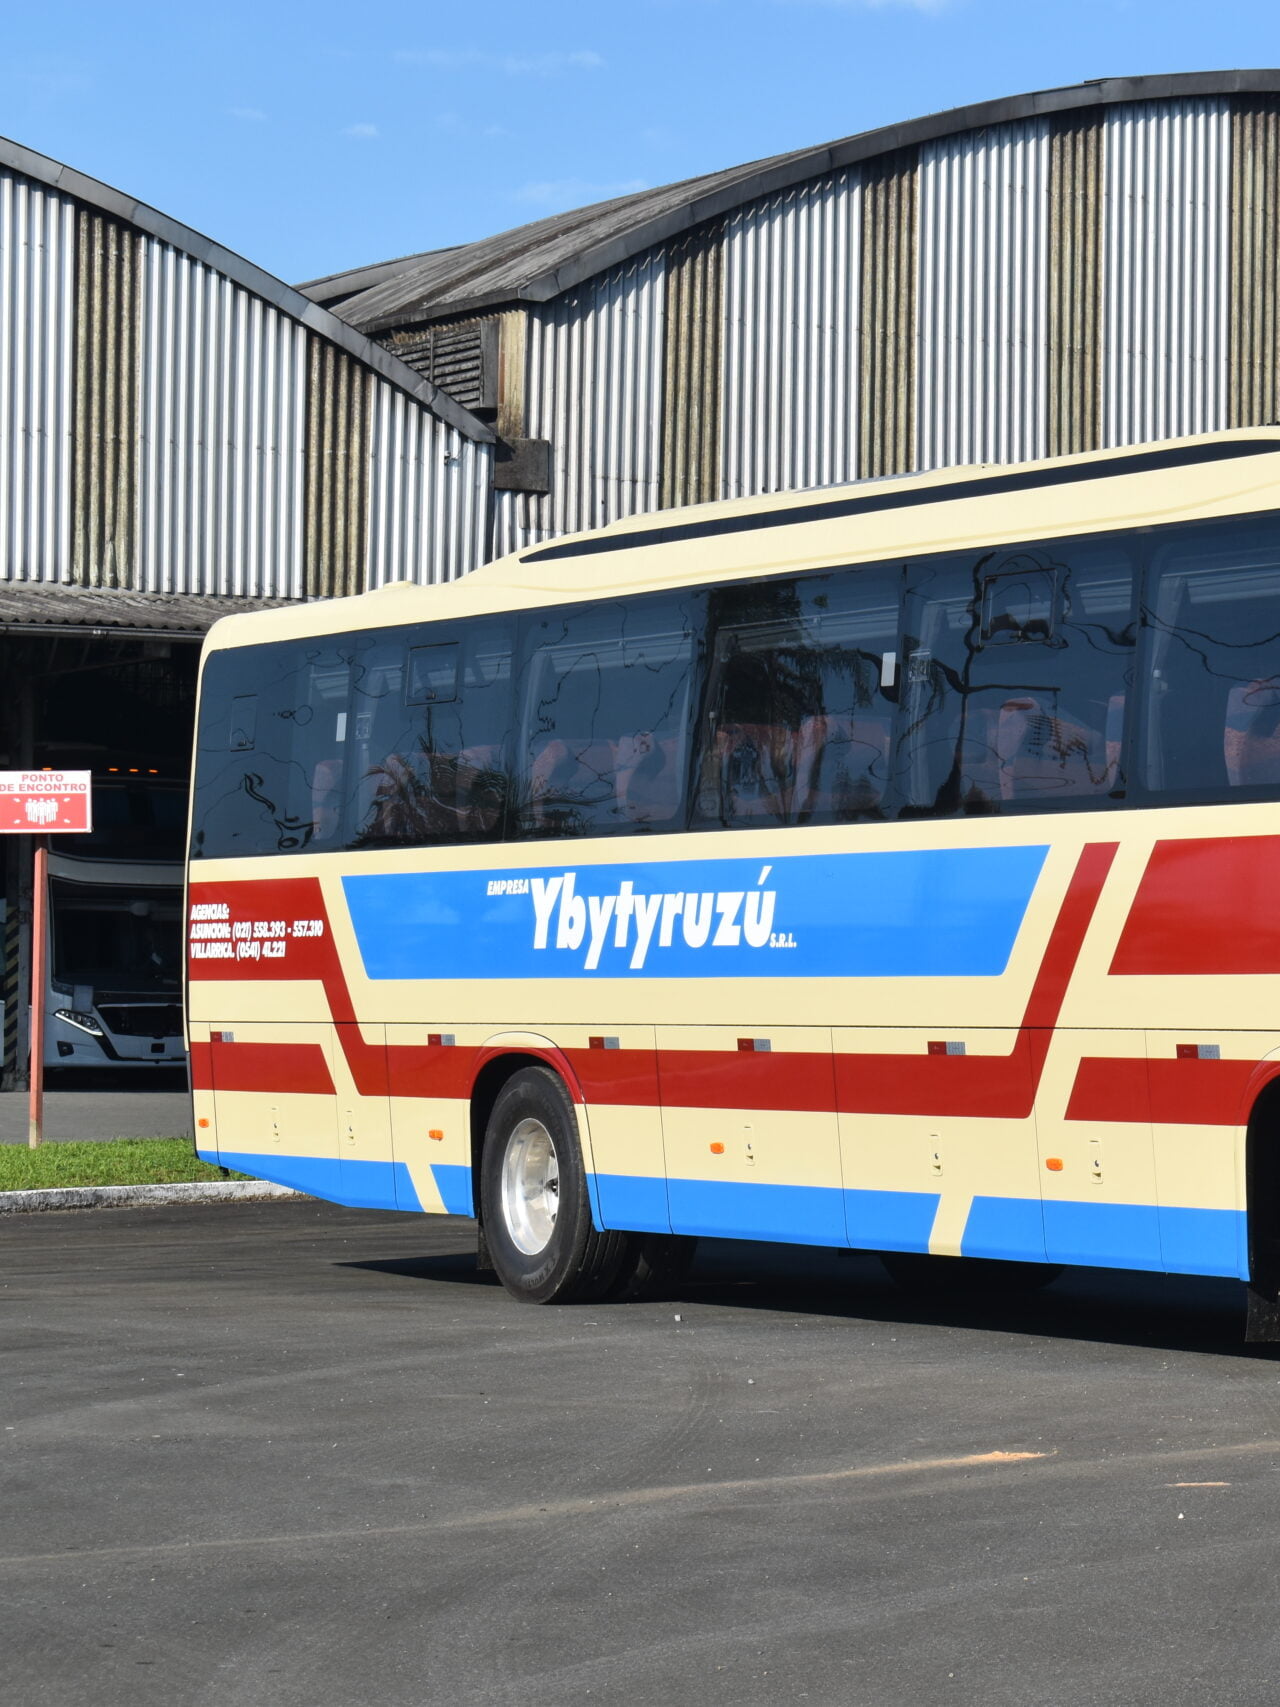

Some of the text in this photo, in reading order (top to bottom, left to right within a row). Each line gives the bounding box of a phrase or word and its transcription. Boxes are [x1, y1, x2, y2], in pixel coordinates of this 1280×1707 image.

[22, 774, 64, 782] PONTO
[0, 783, 87, 792] DE ENCONTRO
[190, 903, 230, 920] AGENCIAS:
[487, 865, 797, 970] EMPRESA Ybytyruzú S.R.L.
[190, 922, 232, 939] ASUNCION:
